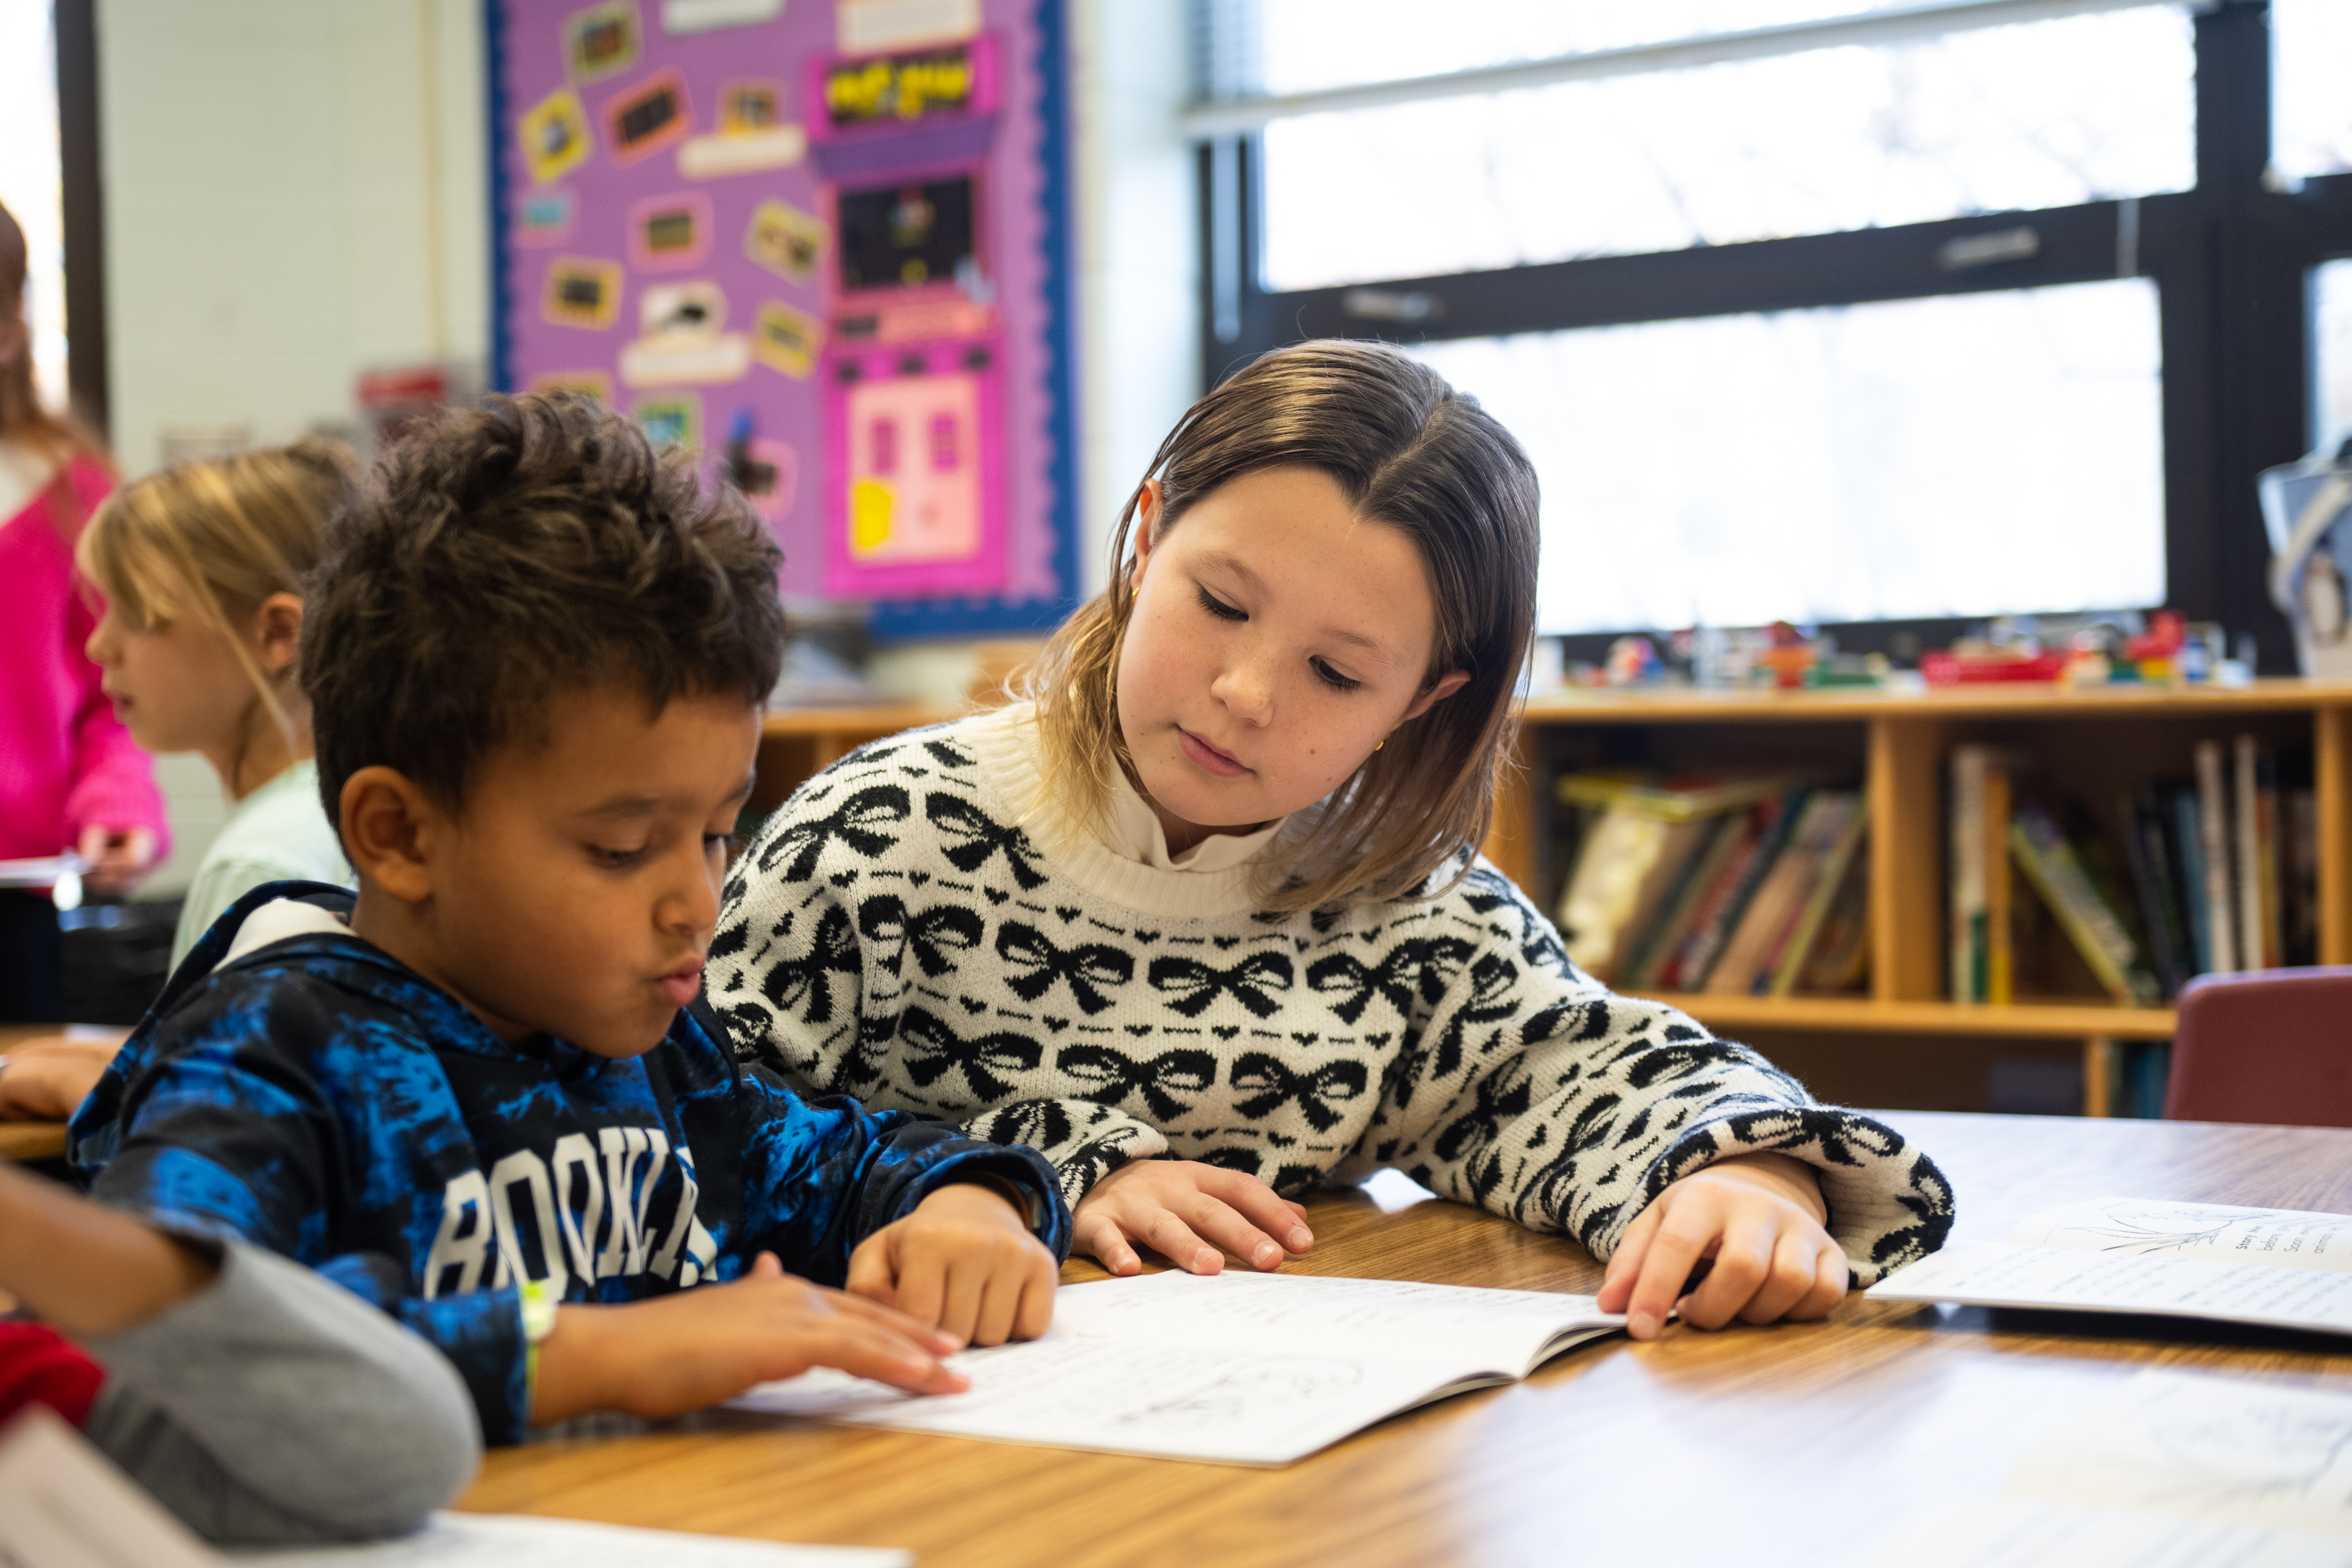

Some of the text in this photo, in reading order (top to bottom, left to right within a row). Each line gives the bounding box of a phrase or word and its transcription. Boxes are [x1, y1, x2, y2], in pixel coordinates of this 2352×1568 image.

[2235, 1234, 2258, 1250] Story
[2256, 1233, 2282, 1251] before
[2283, 1237, 2304, 1252] Soon
[2312, 1233, 2334, 1254] animals
